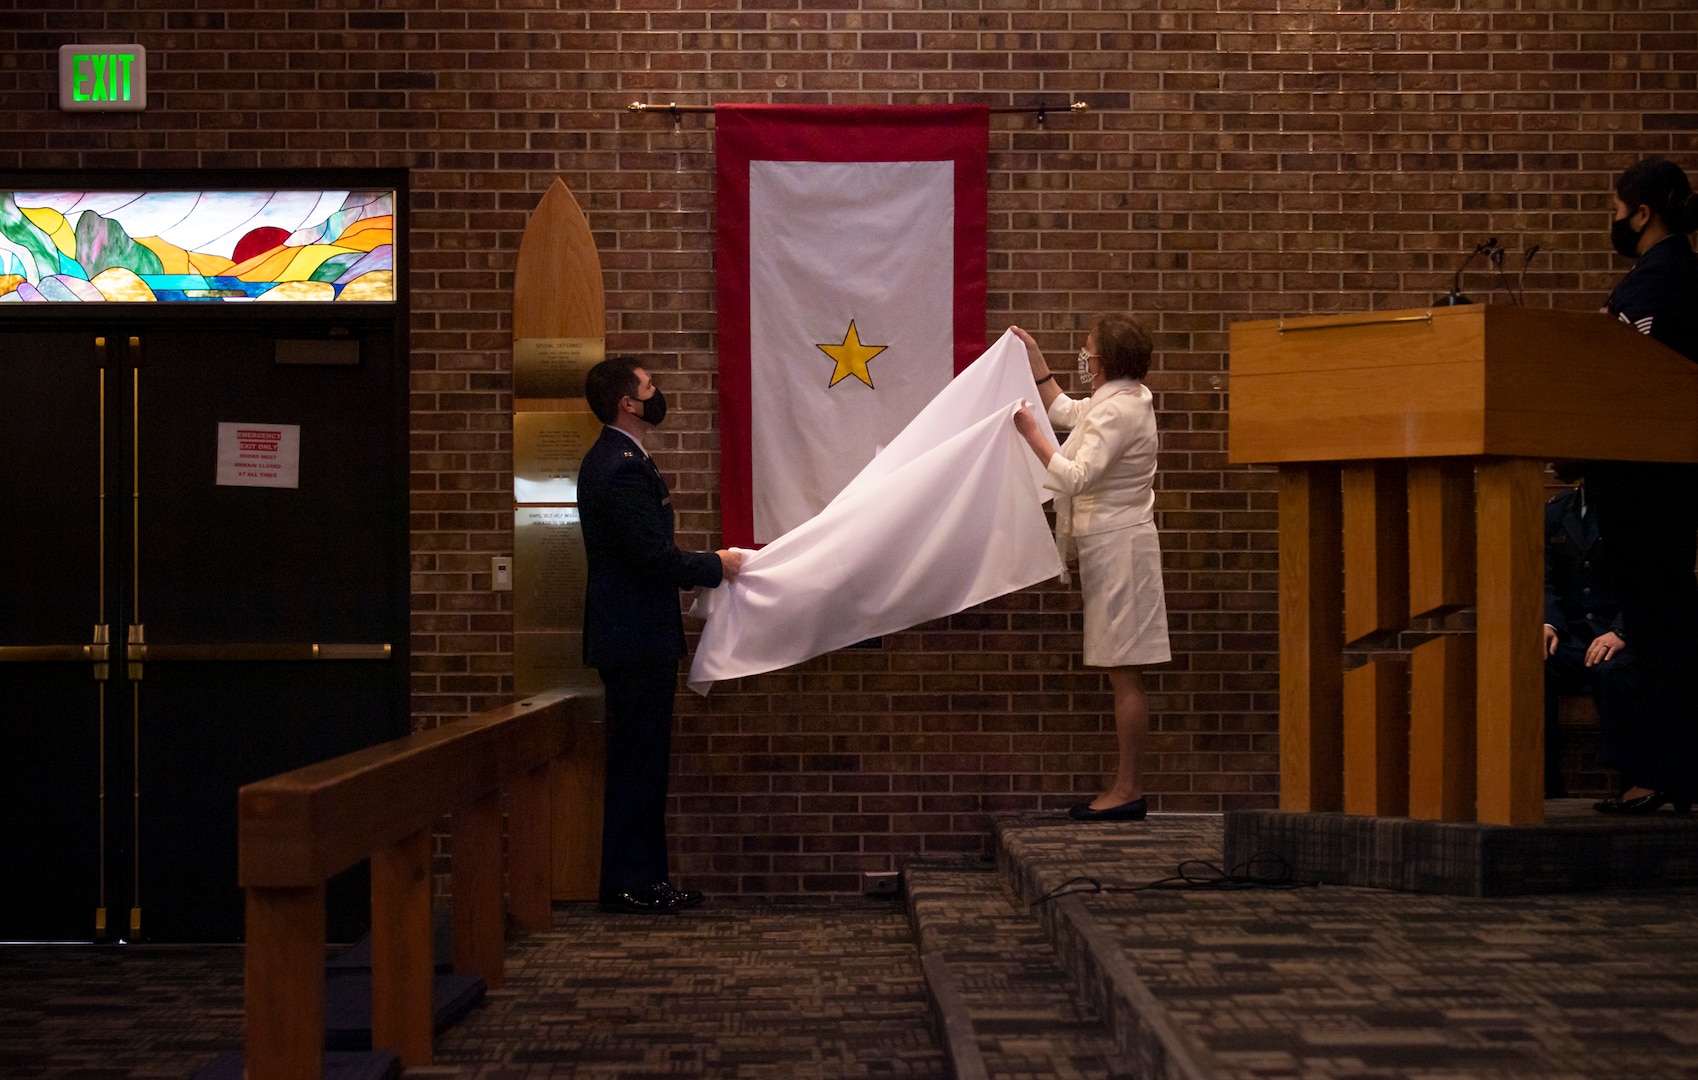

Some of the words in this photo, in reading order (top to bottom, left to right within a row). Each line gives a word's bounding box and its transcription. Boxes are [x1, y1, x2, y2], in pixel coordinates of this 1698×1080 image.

[73, 54, 135, 101] EXIT
[237, 431, 281, 440] EMERGENCY
[258, 443, 278, 451] ONLY
